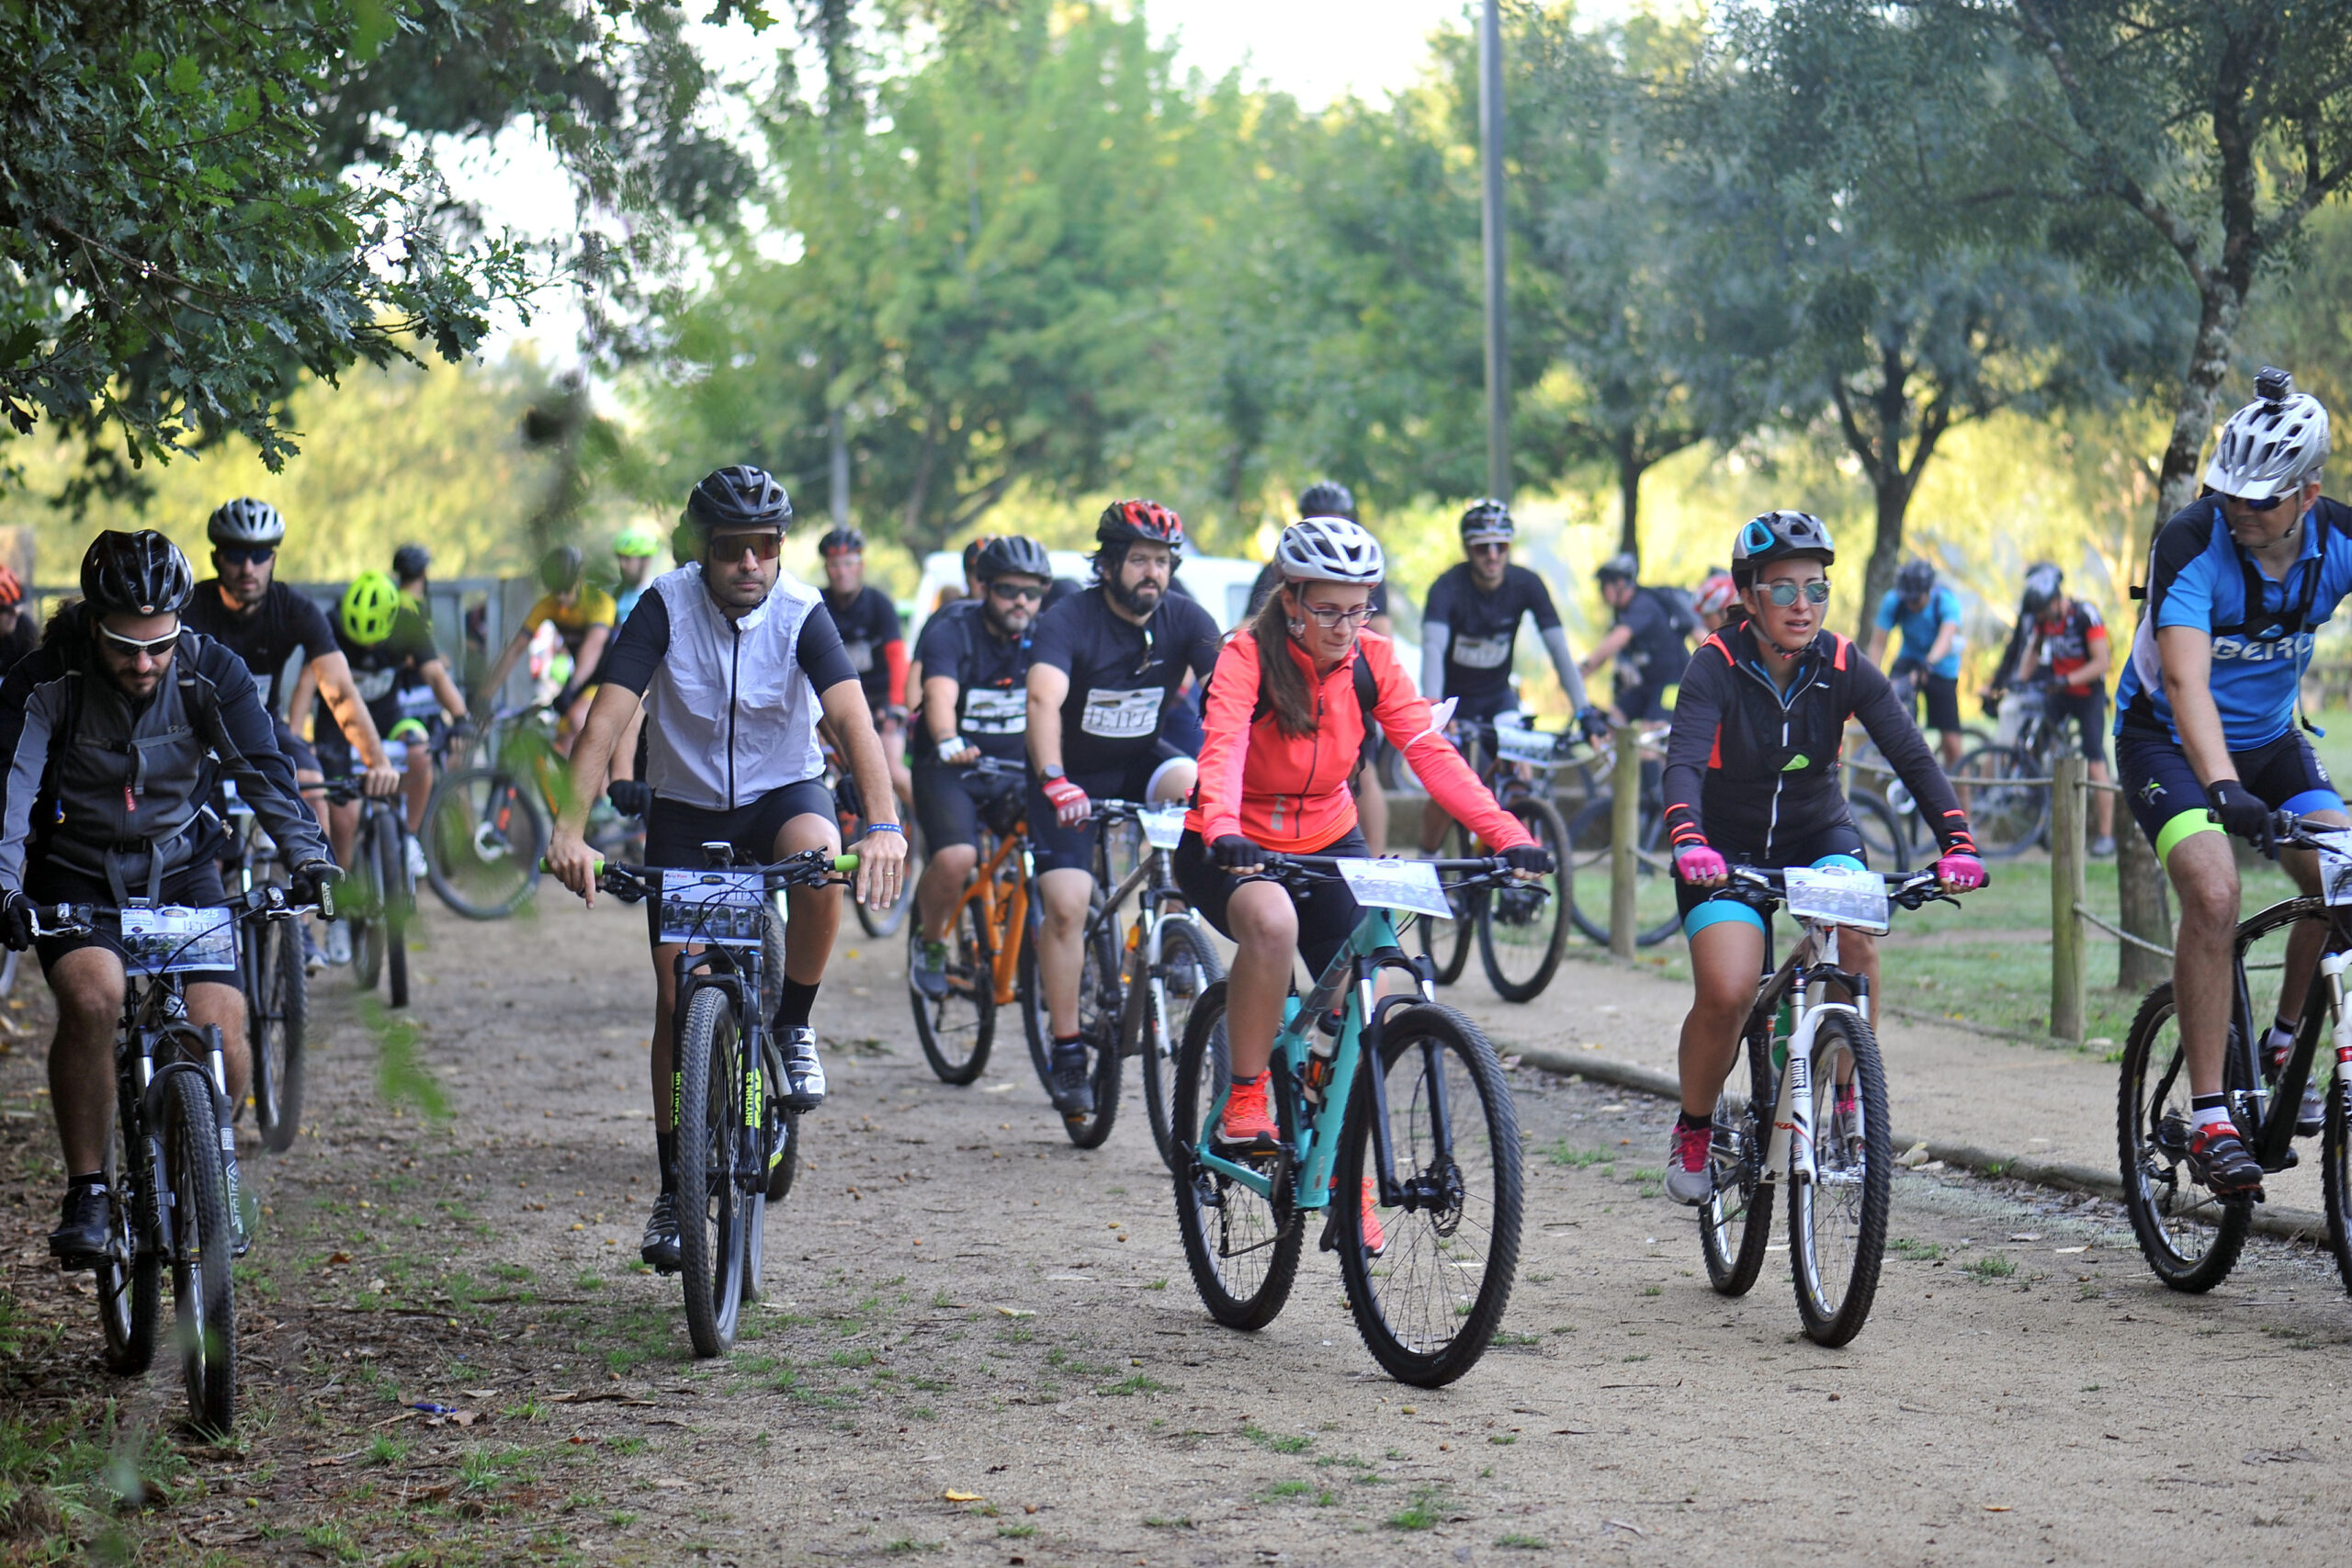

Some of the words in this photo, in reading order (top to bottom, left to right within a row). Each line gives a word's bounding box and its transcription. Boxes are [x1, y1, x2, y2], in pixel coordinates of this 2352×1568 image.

[203, 909, 219, 919] 25
[745, 1072, 753, 1084] 32
[745, 1084, 753, 1126] RHYTHM
